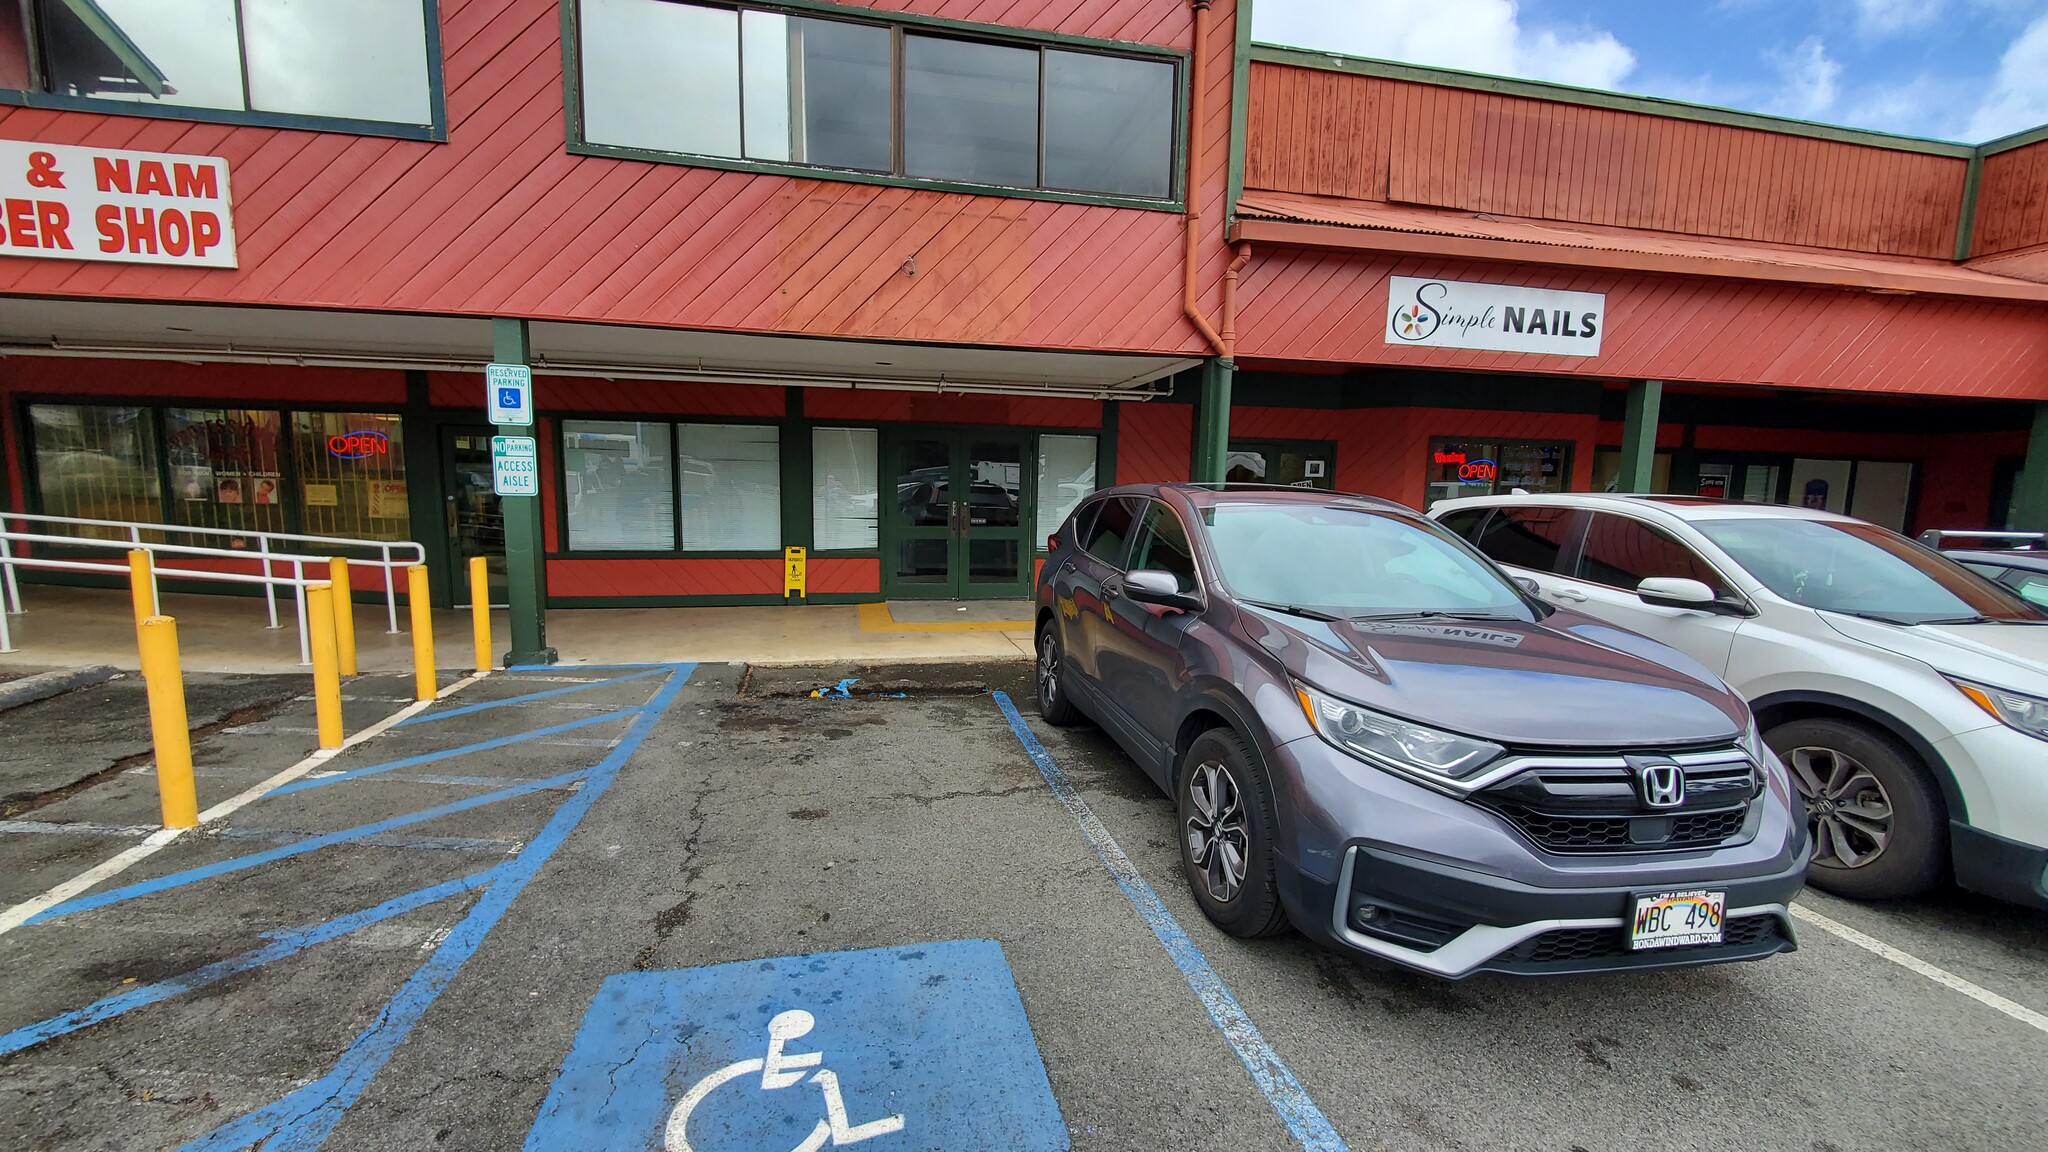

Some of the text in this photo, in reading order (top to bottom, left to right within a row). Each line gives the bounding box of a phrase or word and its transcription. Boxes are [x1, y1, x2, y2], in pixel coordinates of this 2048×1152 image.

[26, 151, 219, 200] & NAM
[0, 198, 221, 257] ER SHOP
[1392, 282, 1598, 341] Simple NAILS
[490, 368, 527, 378] RESERVED
[493, 378, 525, 387] PARKING
[329, 435, 387, 454] OPEN
[494, 441, 533, 453] NO PARKING
[497, 460, 533, 471] ACCESS
[1458, 464, 1496, 479] OPEN
[503, 475, 530, 487] AISLE
[1676, 890, 1707, 898] BELIEVER
[1635, 901, 1721, 934] WBC 498
[1632, 933, 1721, 950] HONDAWINDWARD.COM
